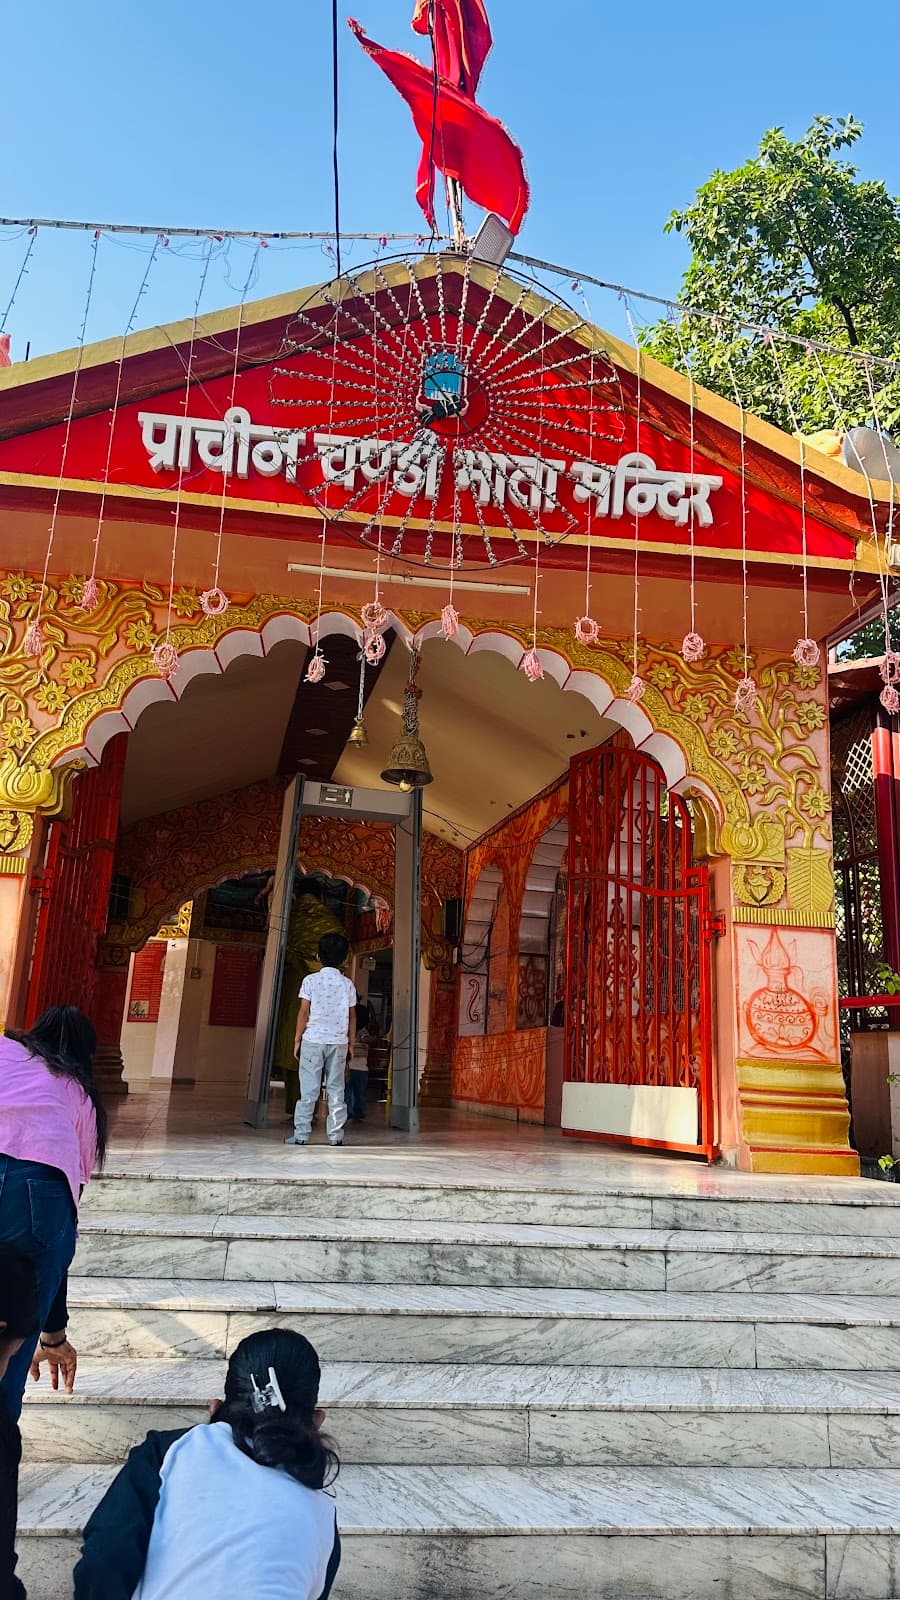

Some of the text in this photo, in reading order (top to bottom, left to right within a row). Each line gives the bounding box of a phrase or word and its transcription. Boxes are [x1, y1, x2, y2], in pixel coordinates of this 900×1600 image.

[138, 407, 722, 527] प्राचीन चण्डी माता मन्दिर
